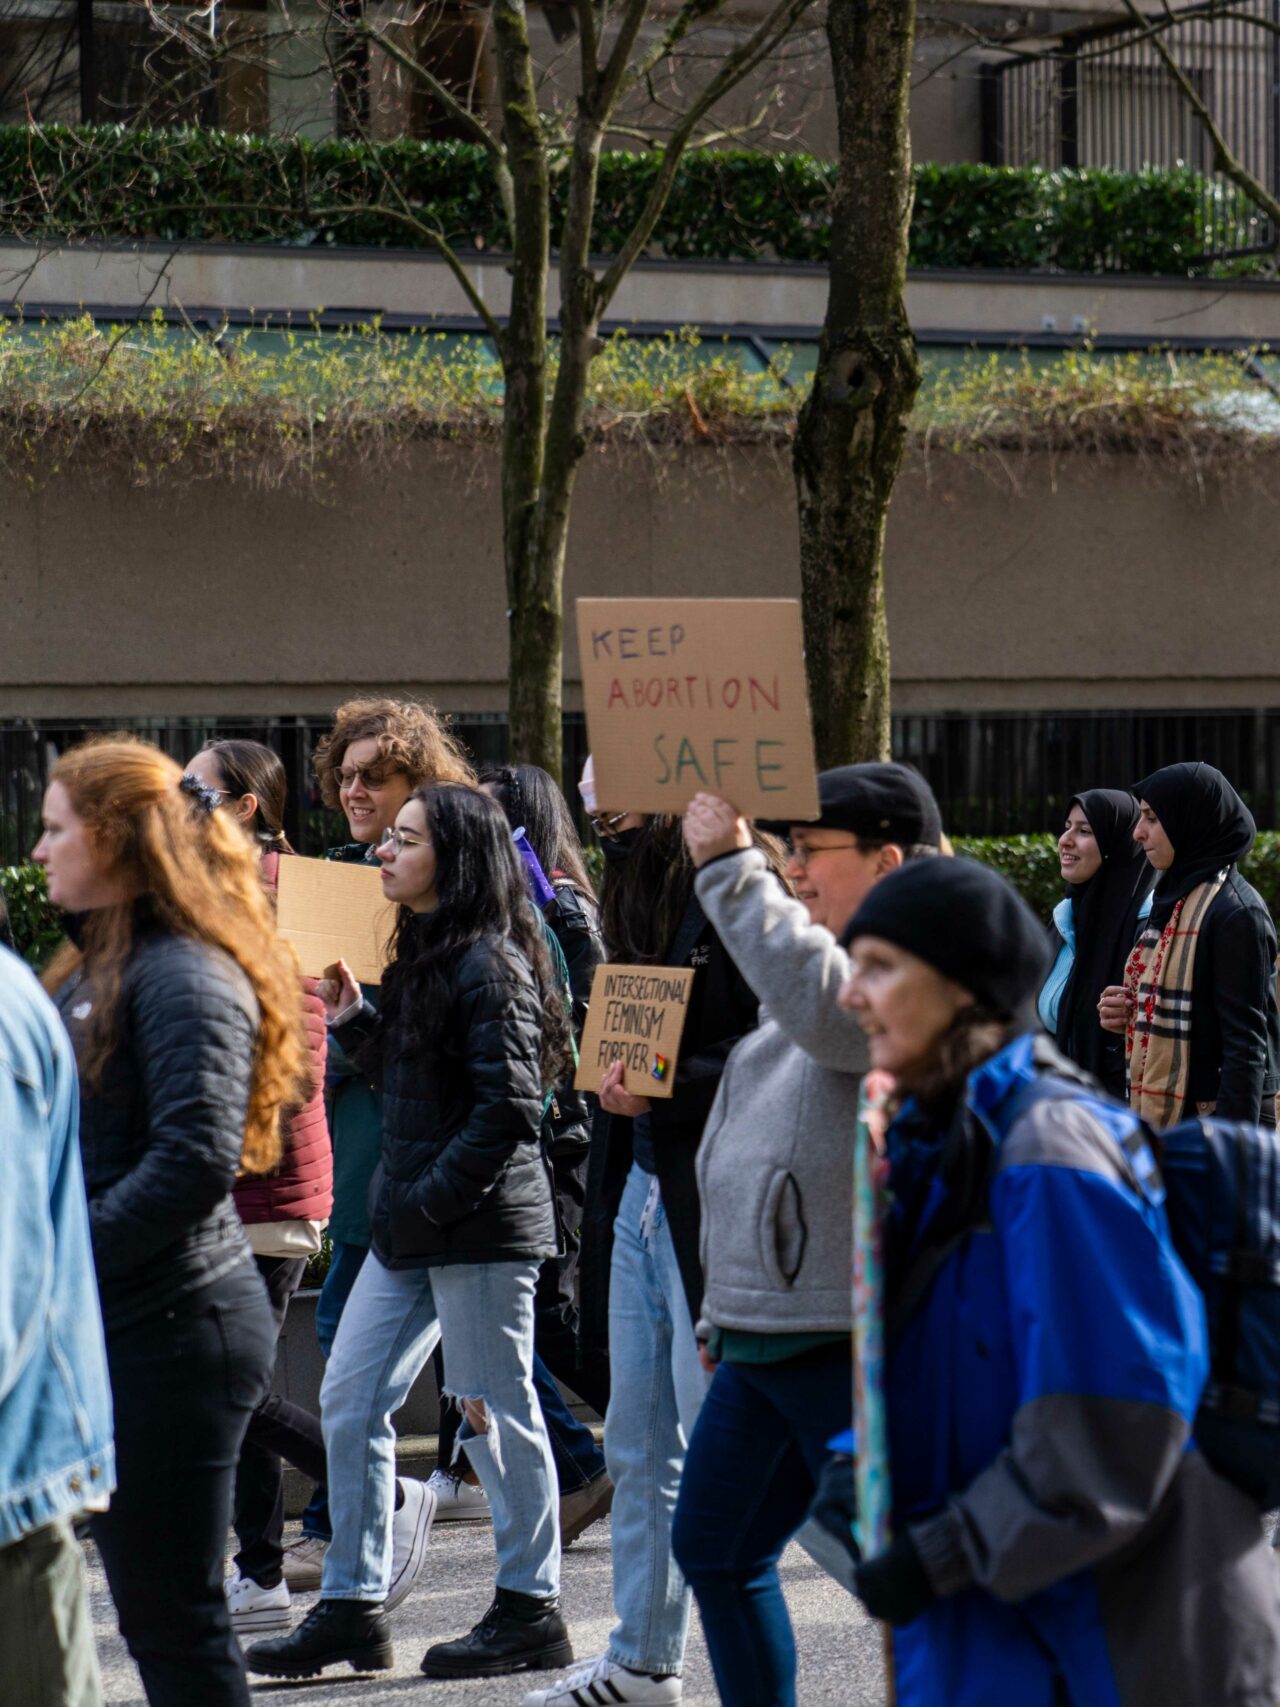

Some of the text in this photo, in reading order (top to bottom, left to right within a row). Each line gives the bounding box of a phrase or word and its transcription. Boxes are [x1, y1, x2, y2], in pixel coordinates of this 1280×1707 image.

[591, 624, 685, 660] KEEP
[607, 675, 780, 712] ABORTION
[654, 734, 788, 792] SAFE
[604, 975, 687, 1004] INTERSECTIONAL
[604, 1000, 665, 1042] FEMINISM
[597, 1040, 649, 1073] FOREVER
